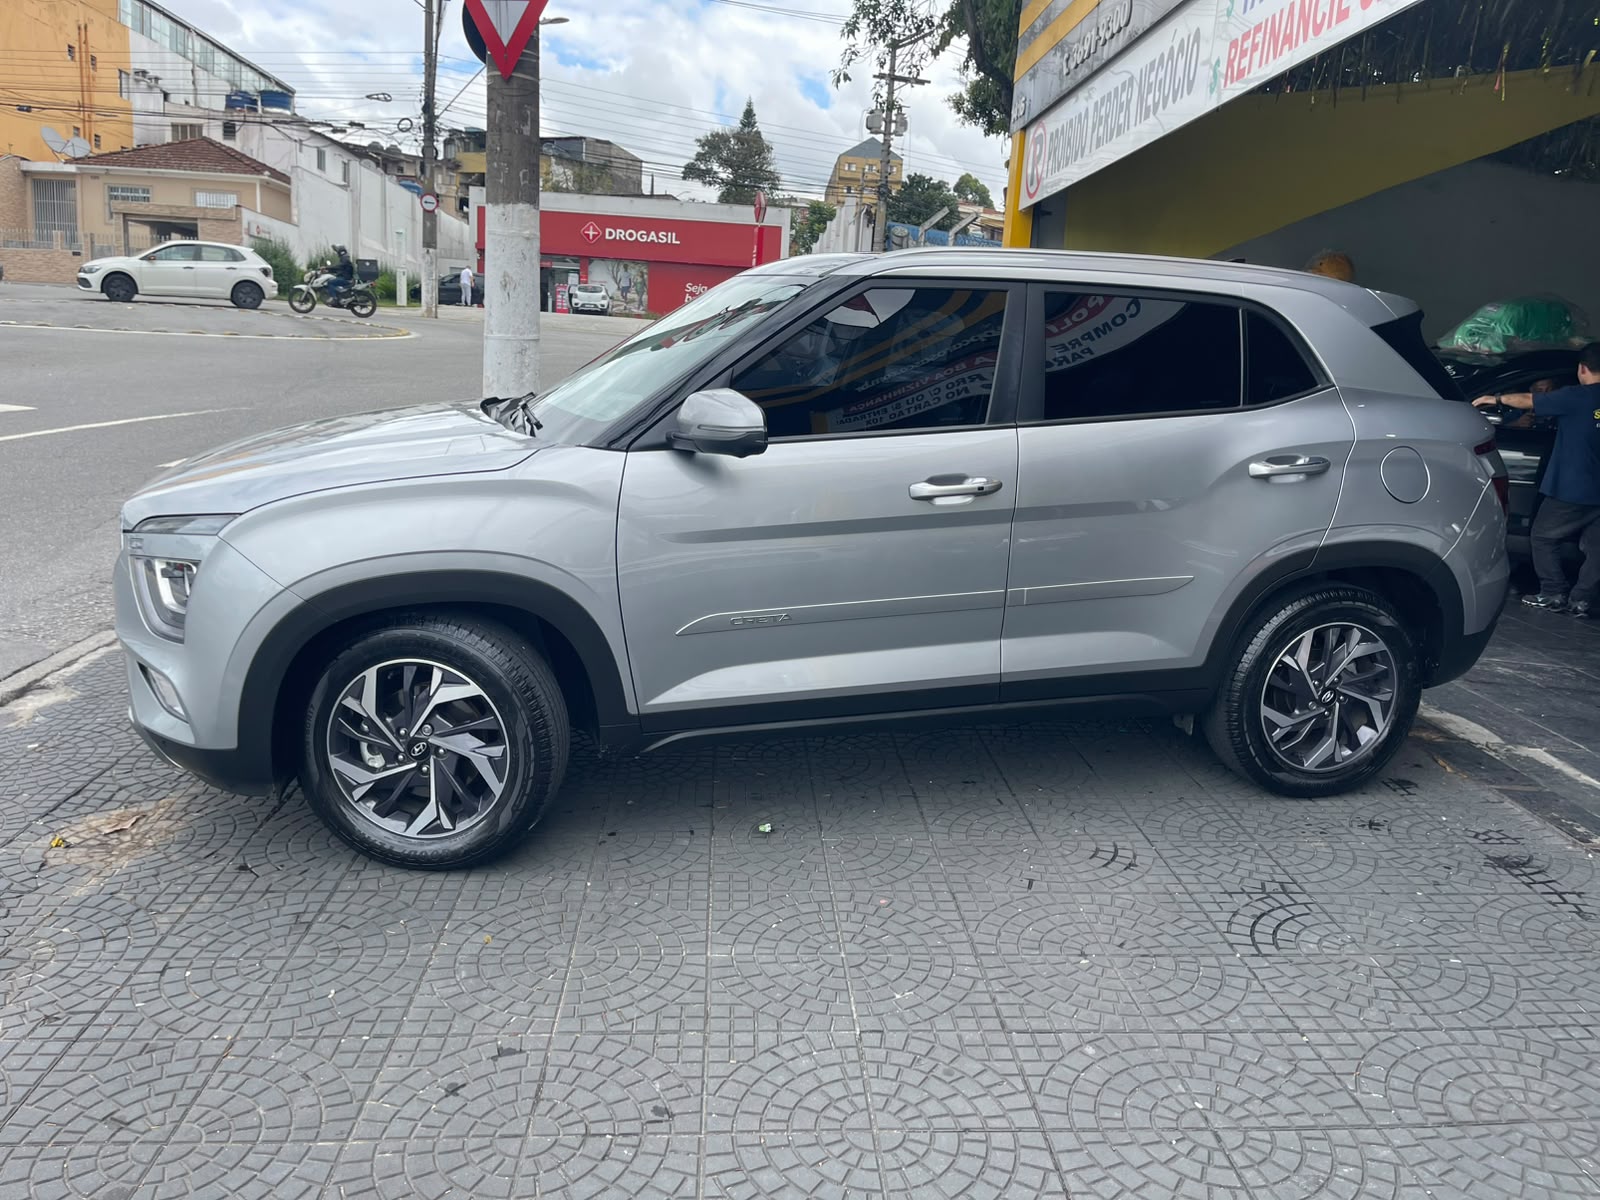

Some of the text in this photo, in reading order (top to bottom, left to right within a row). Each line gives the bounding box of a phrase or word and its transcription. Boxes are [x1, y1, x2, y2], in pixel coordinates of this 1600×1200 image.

[1071, 0, 1131, 70] 3691-9300
[1046, 27, 1201, 179] PROIBIDO PERDER NEGÓCIO
[605, 227, 681, 245] DROGASIL
[685, 282, 708, 294] Seja
[729, 613, 793, 626] CRETA
